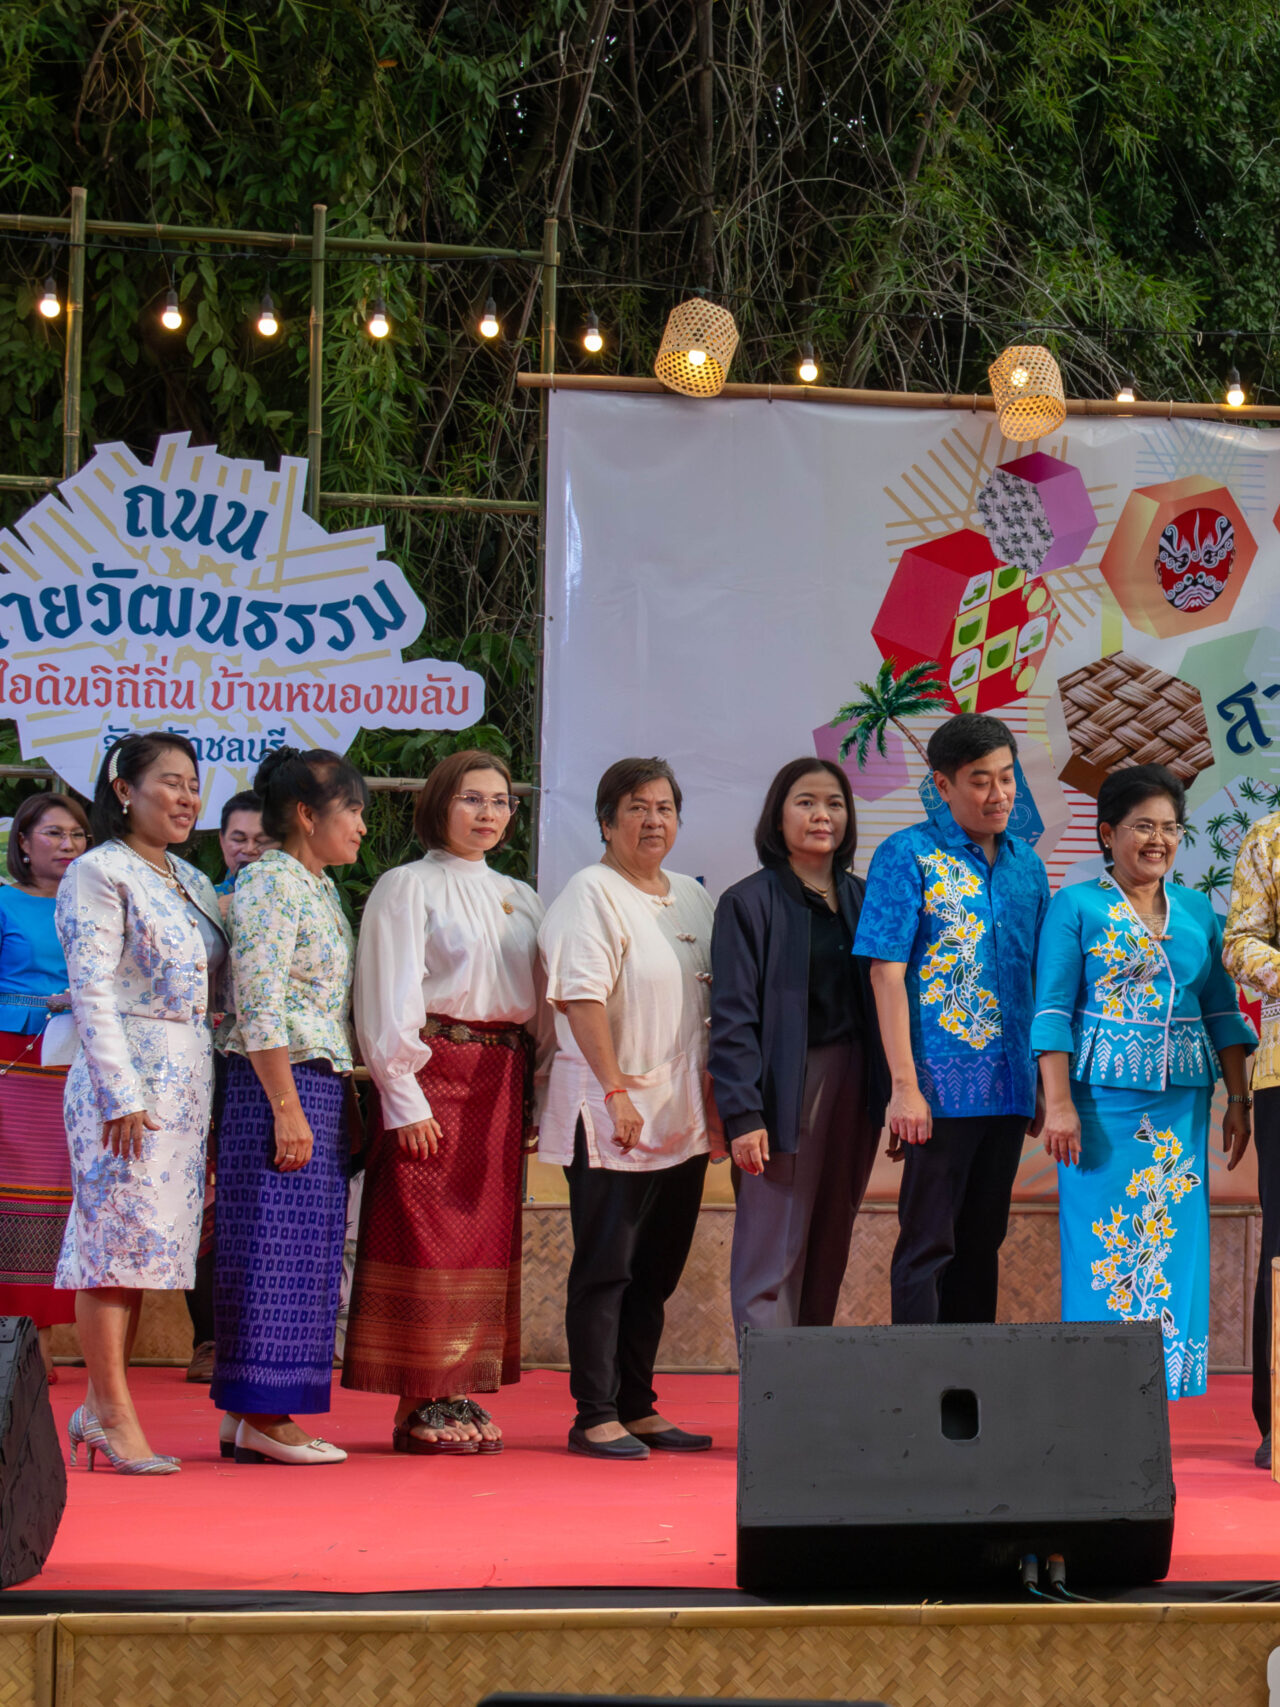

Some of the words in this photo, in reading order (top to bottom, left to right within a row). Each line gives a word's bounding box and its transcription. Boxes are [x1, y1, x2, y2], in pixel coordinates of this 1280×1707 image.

[124, 485, 268, 560] ถนน
[0, 563, 407, 655] ายวัฒนธรรม
[211, 666, 469, 716] บ้านหนองพลับ
